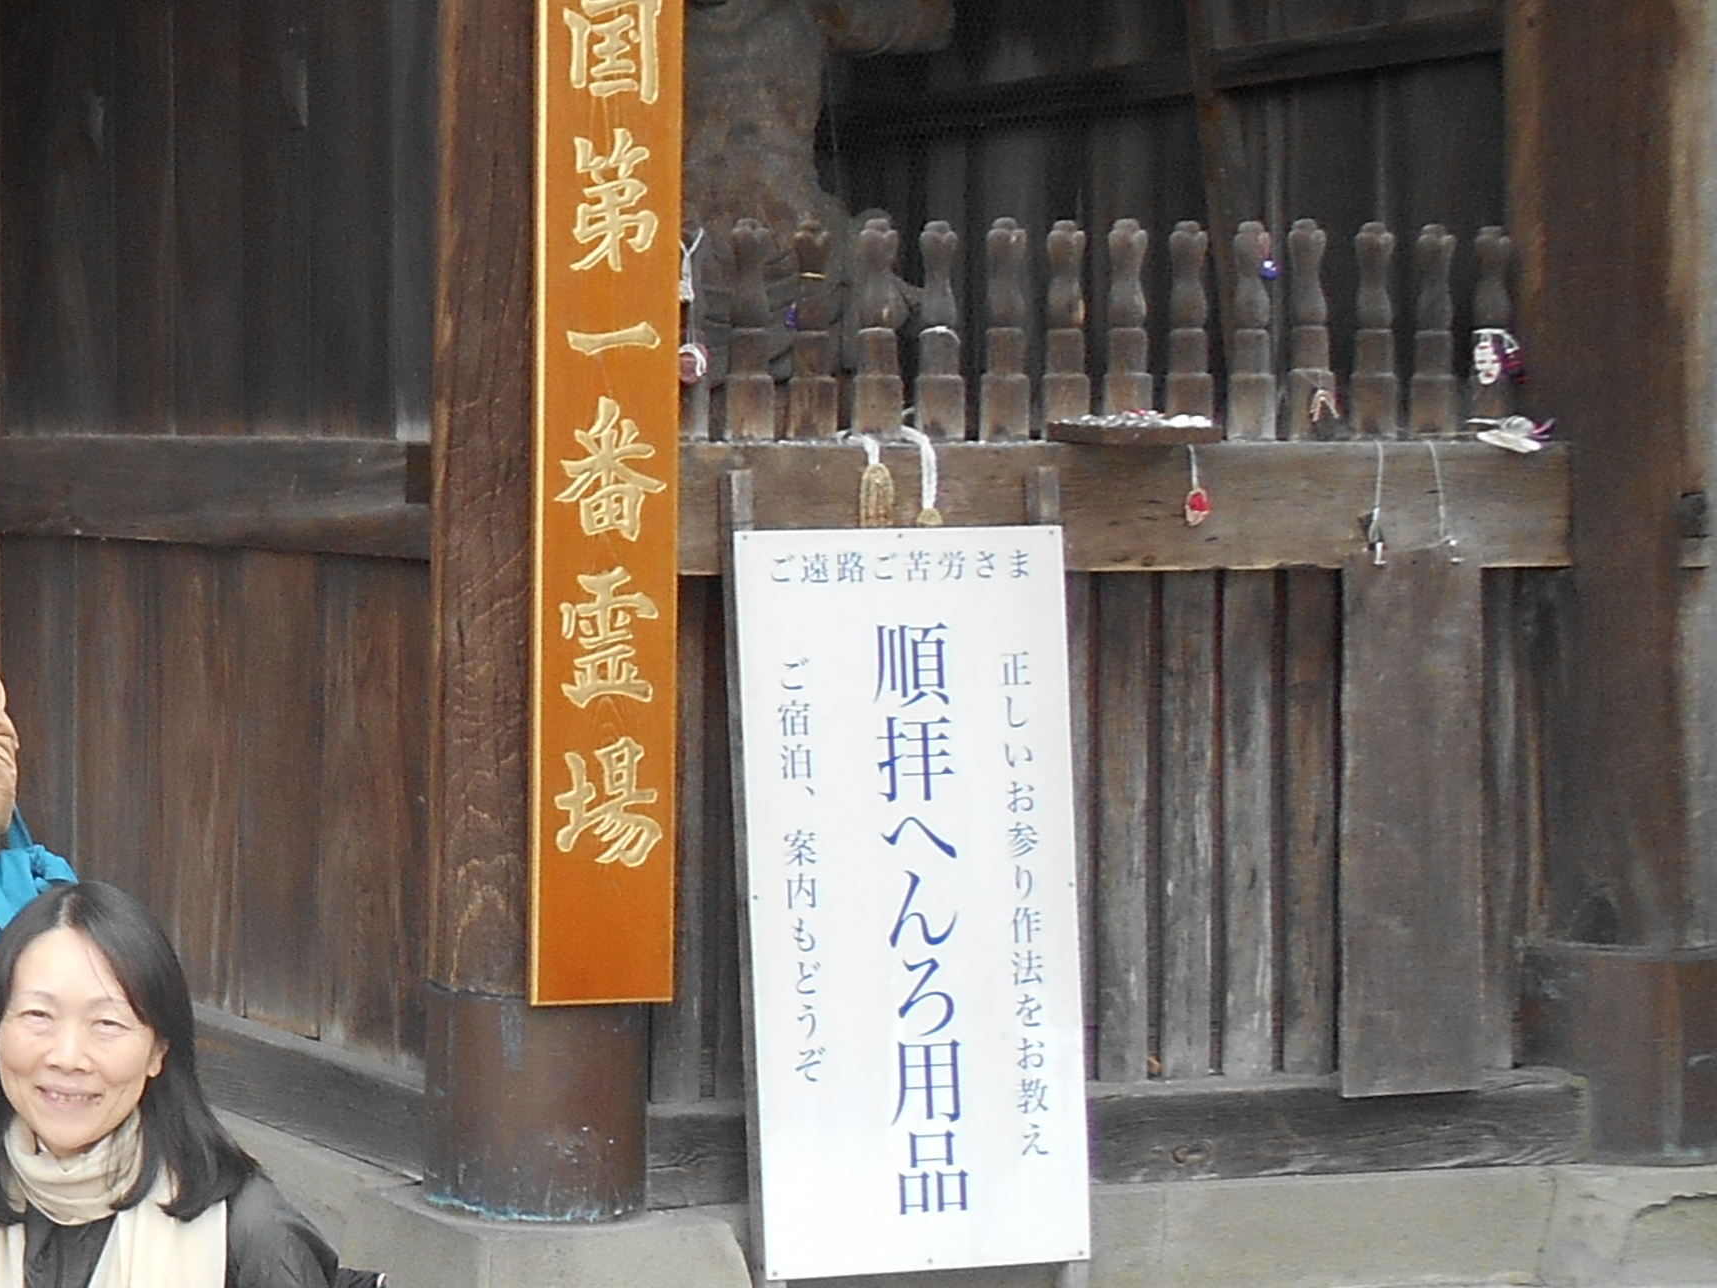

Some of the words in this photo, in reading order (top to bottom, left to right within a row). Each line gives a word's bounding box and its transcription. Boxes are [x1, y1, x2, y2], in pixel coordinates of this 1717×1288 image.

[769, 548, 1033, 584] ご遠路ご苦労さま
[778, 658, 826, 1085] ご宿泊、案内もどうぞ
[873, 621, 970, 1217] 順拝へんろ用品
[999, 649, 1051, 1158] 正しいお参り作法をお教え
